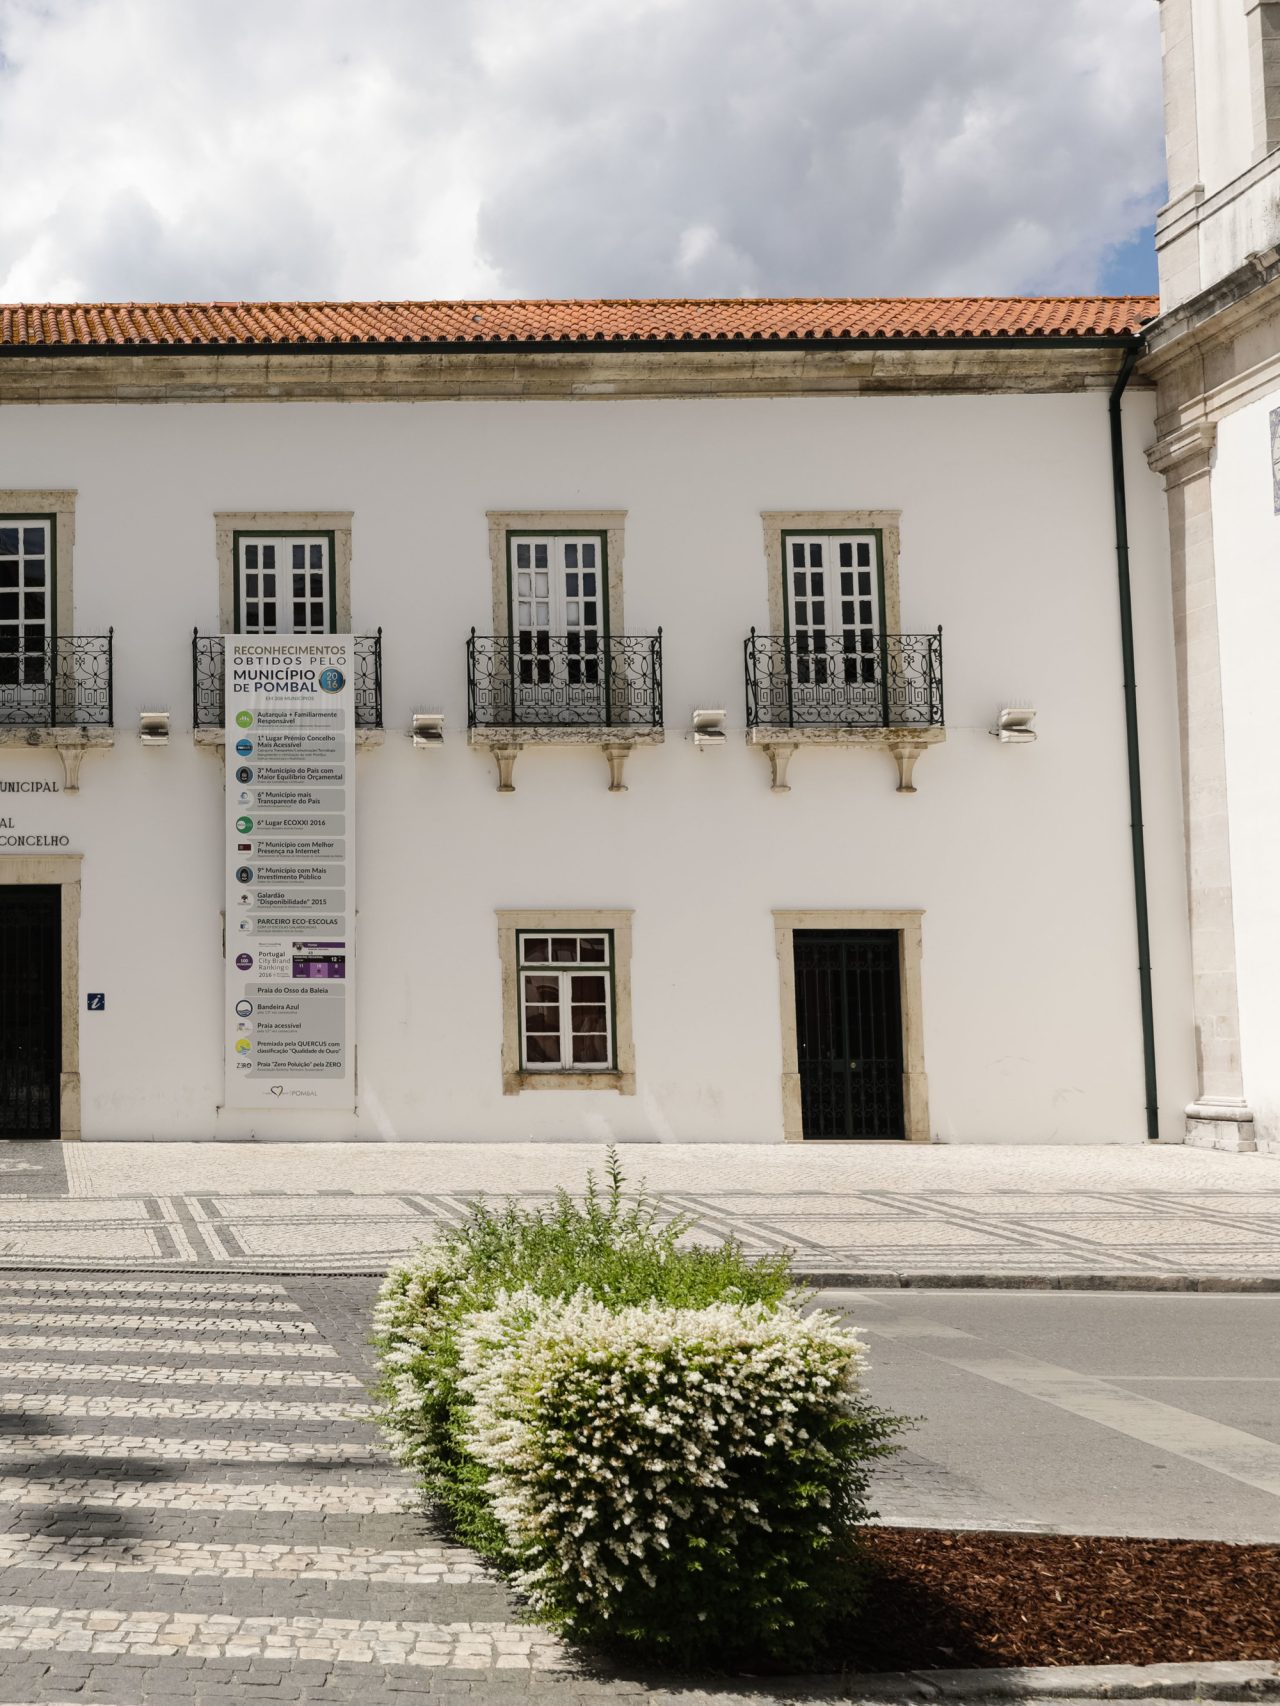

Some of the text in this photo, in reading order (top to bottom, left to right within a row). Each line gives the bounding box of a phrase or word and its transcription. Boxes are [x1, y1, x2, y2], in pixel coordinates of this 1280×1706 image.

[234, 646, 346, 655] RECONHECIMENTOS
[234, 657, 346, 666] OBTIDOS PELO
[234, 667, 315, 680] MUNICÍPIO
[326, 672, 337, 680] 20
[234, 682, 317, 692] DE POMBAL
